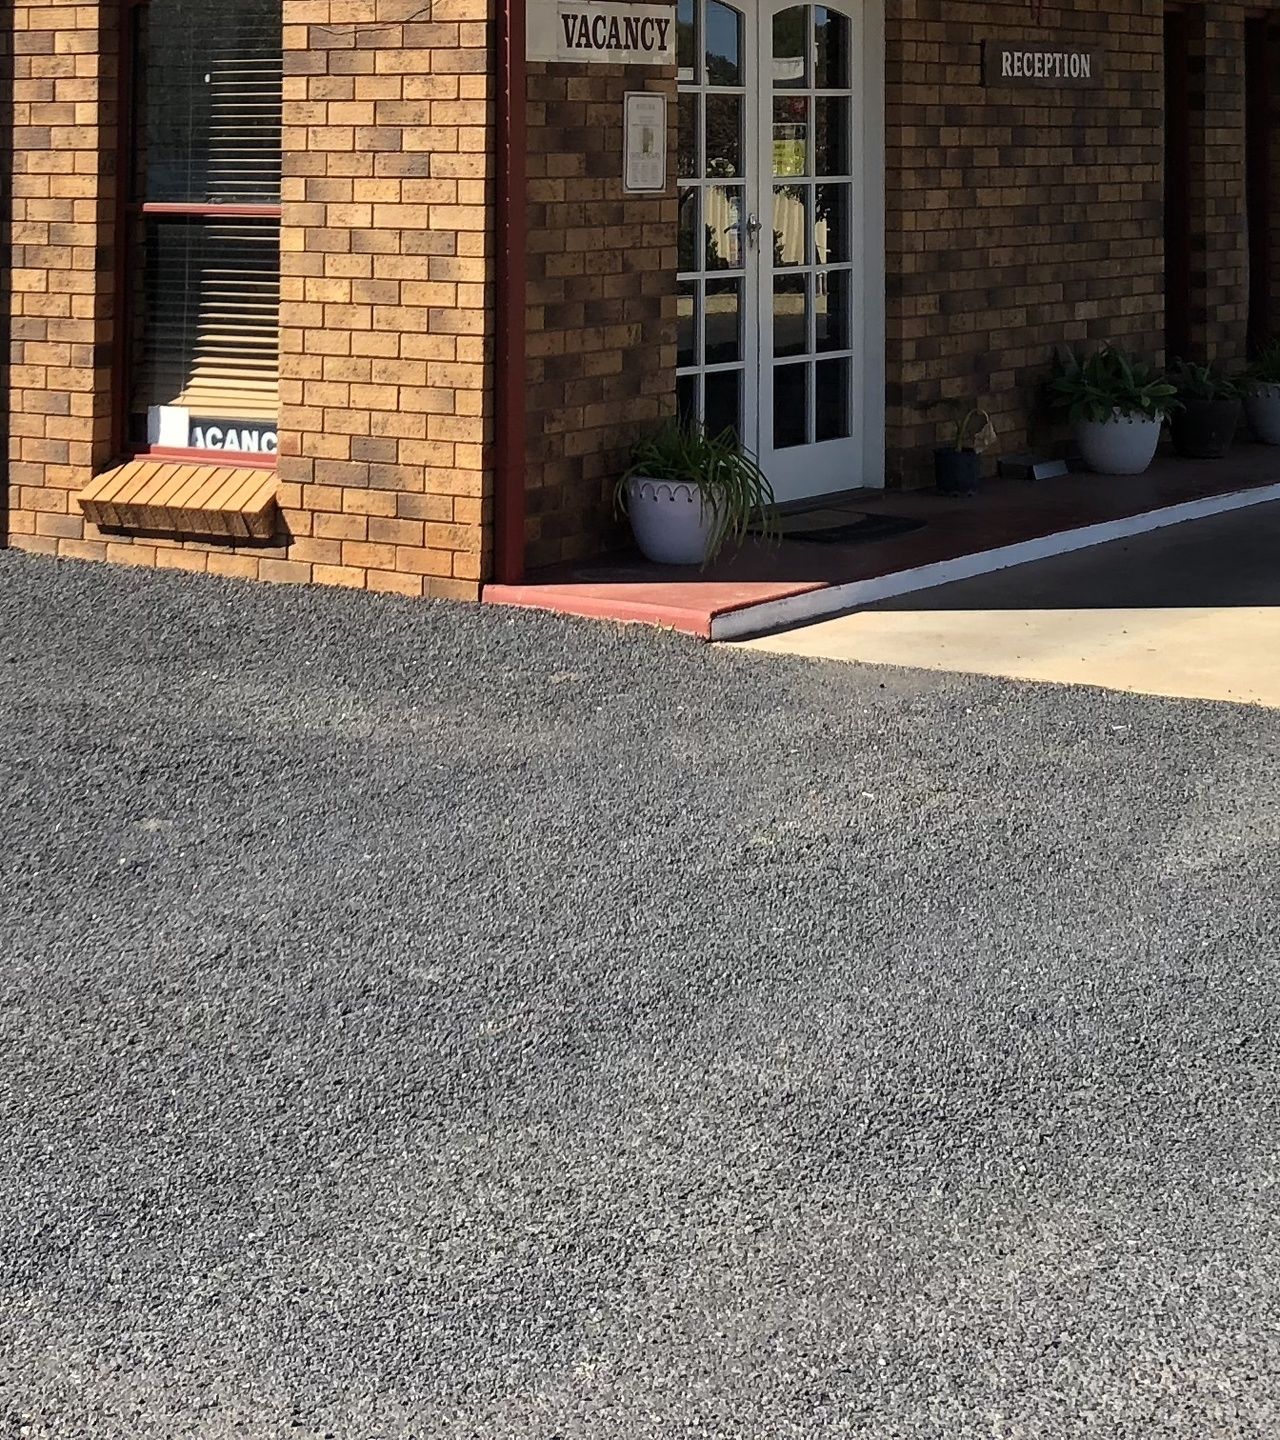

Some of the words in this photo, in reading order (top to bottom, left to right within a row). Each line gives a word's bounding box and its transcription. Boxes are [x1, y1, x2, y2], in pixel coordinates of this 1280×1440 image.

[561, 14, 670, 51] VACANCY
[1001, 51, 1091, 78] RECEPTION
[191, 426, 278, 453] ACANC
